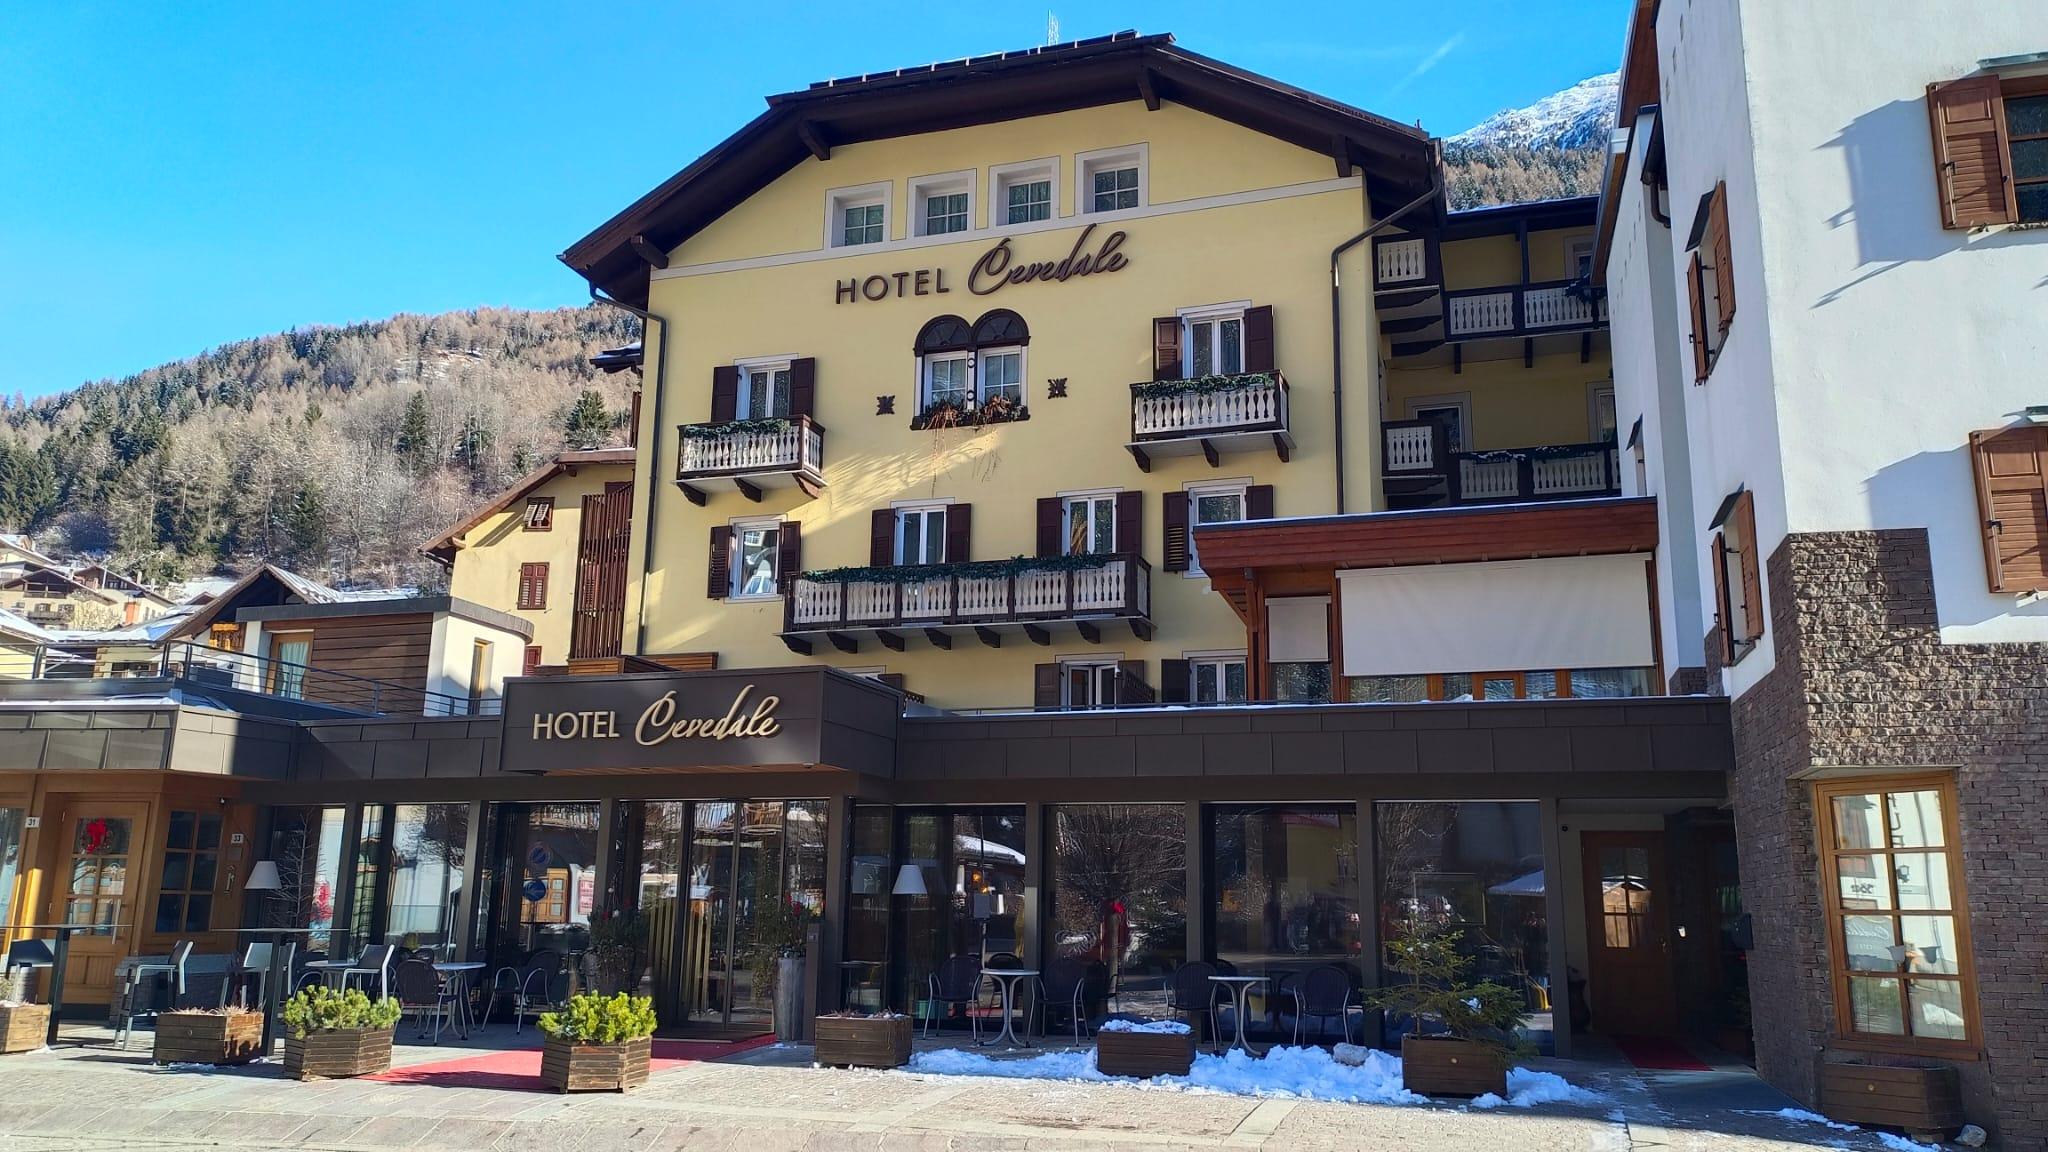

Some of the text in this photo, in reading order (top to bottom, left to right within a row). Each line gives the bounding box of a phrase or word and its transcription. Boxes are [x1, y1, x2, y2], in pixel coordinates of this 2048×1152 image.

[835, 223, 1129, 304] HOTEL Cevedale
[532, 684, 781, 746] HOTEL Cevedale
